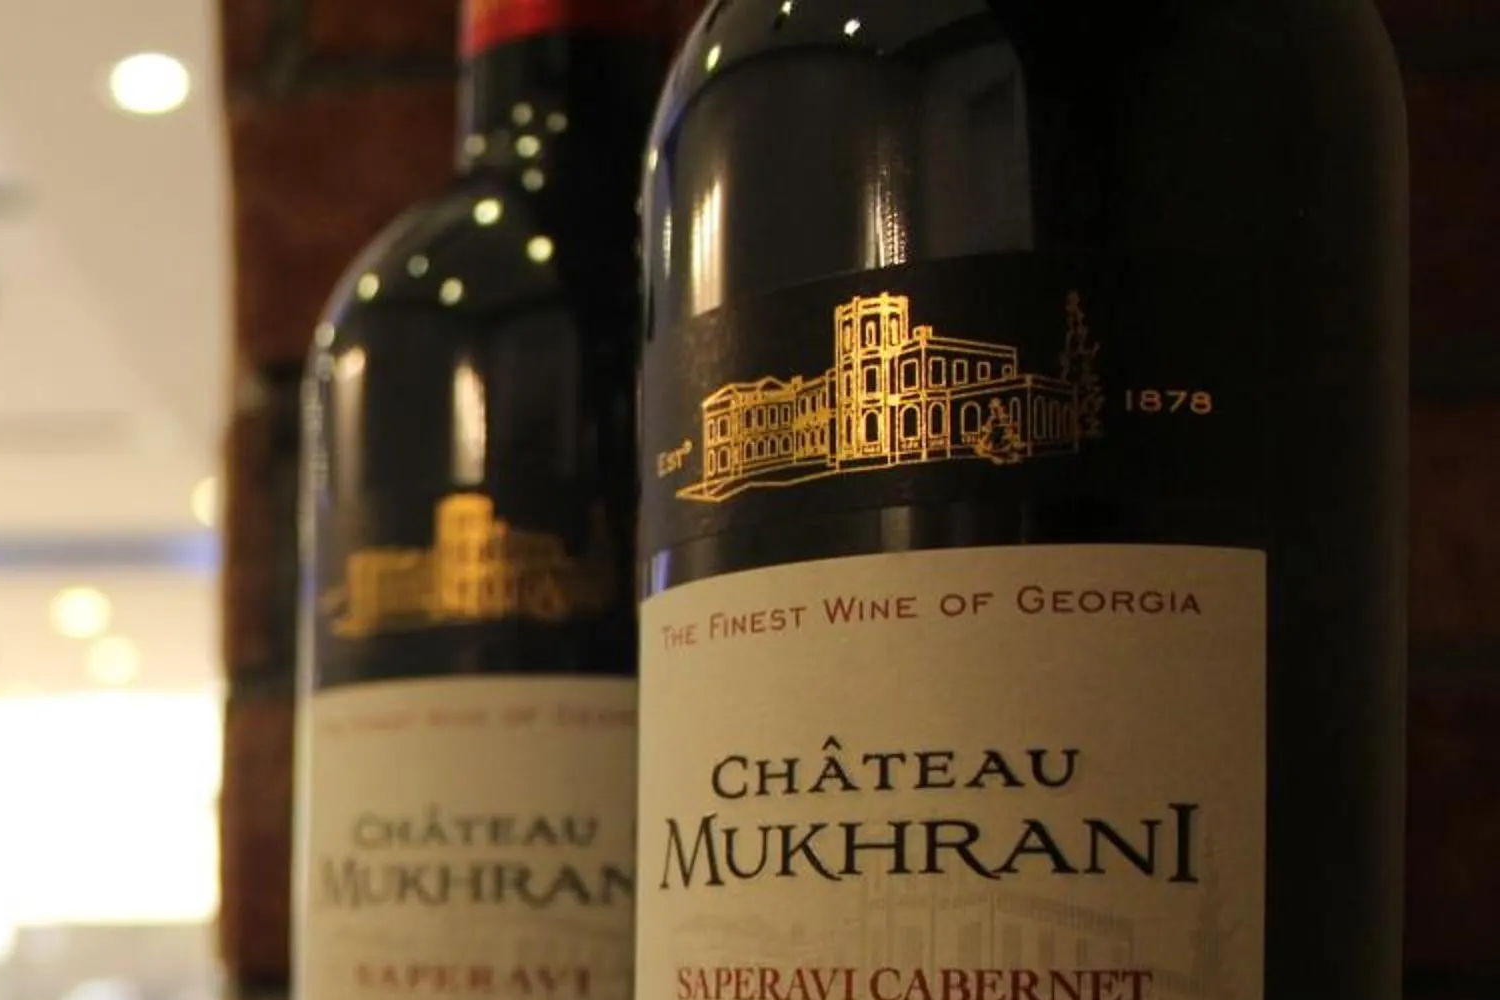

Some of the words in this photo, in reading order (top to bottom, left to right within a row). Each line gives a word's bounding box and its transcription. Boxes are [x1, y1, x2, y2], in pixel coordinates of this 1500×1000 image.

[1124, 391, 1213, 415] 1878
[711, 735, 1081, 800] CHÂTEAU
[659, 802, 1199, 890] MUKHRANI
[318, 857, 638, 910] MUKHRAN
